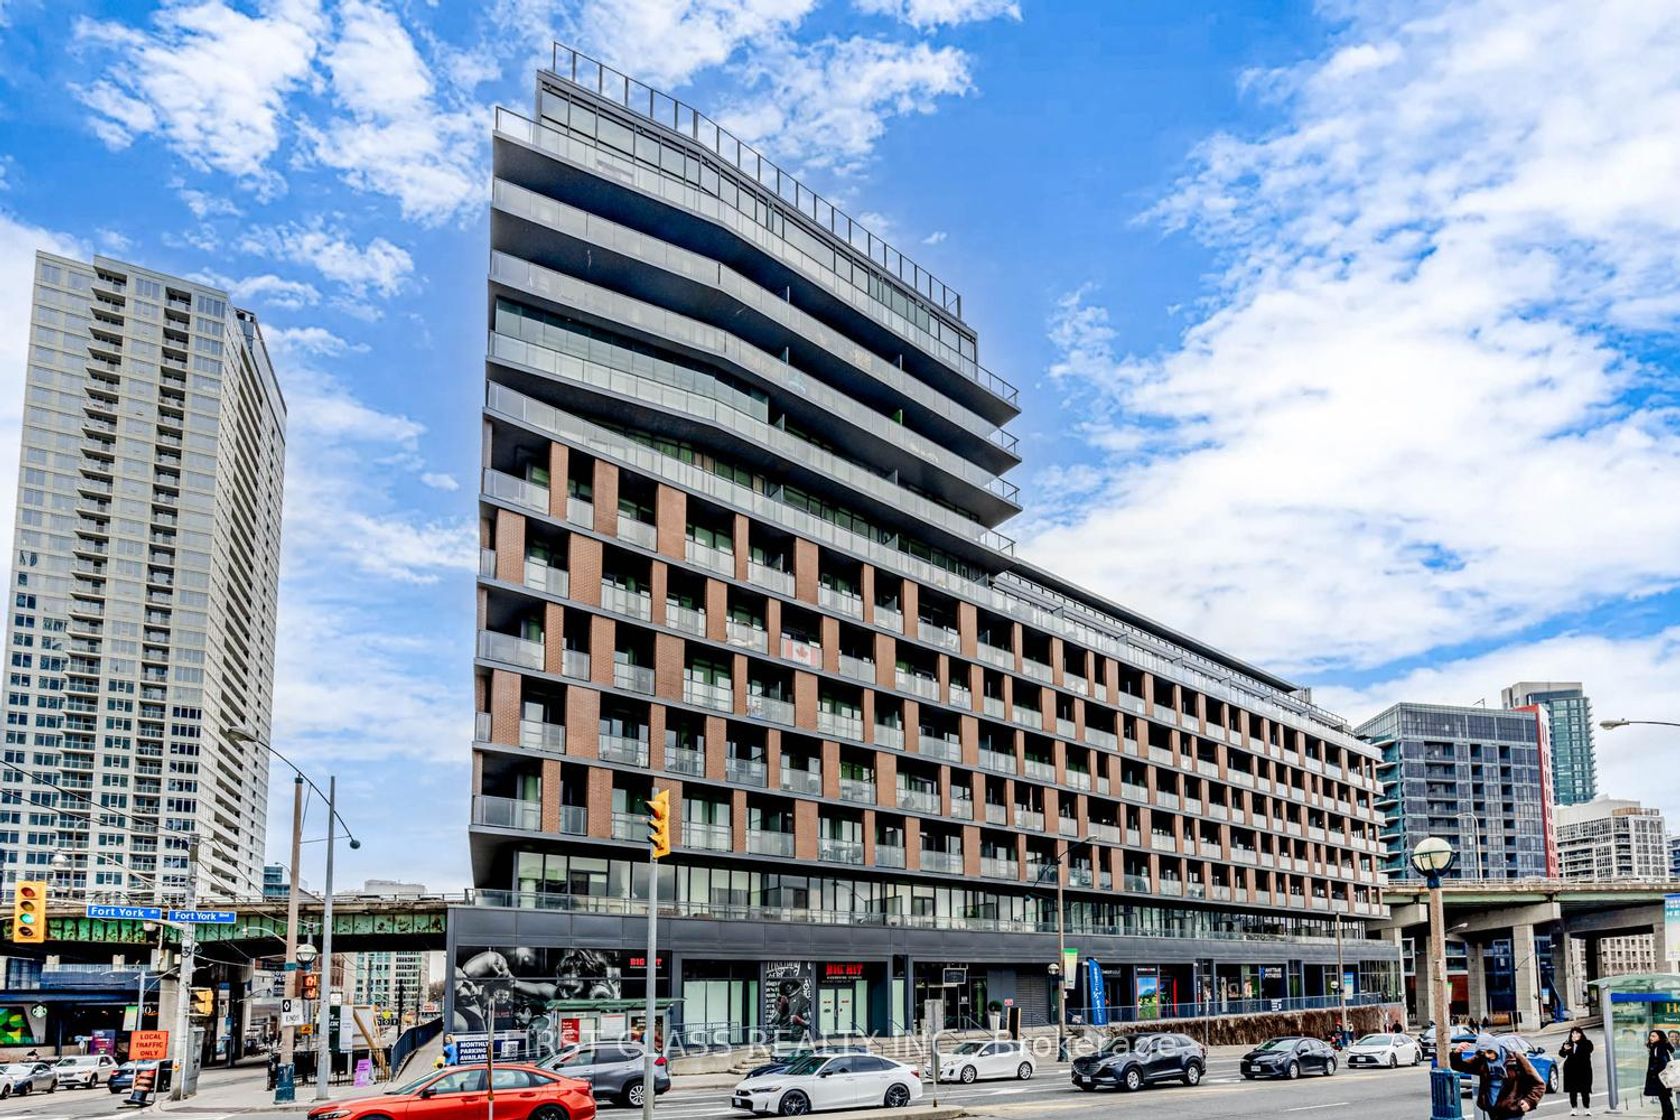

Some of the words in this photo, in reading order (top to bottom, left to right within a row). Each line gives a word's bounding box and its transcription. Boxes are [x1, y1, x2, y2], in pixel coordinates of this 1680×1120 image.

[91, 907, 115, 916] Fort
[119, 908, 144, 917] York
[175, 912, 194, 920] Fort
[196, 912, 216, 920] York
[630, 958, 644, 966] BIG
[827, 963, 843, 975] BIG
[846, 963, 863, 975] HIT
